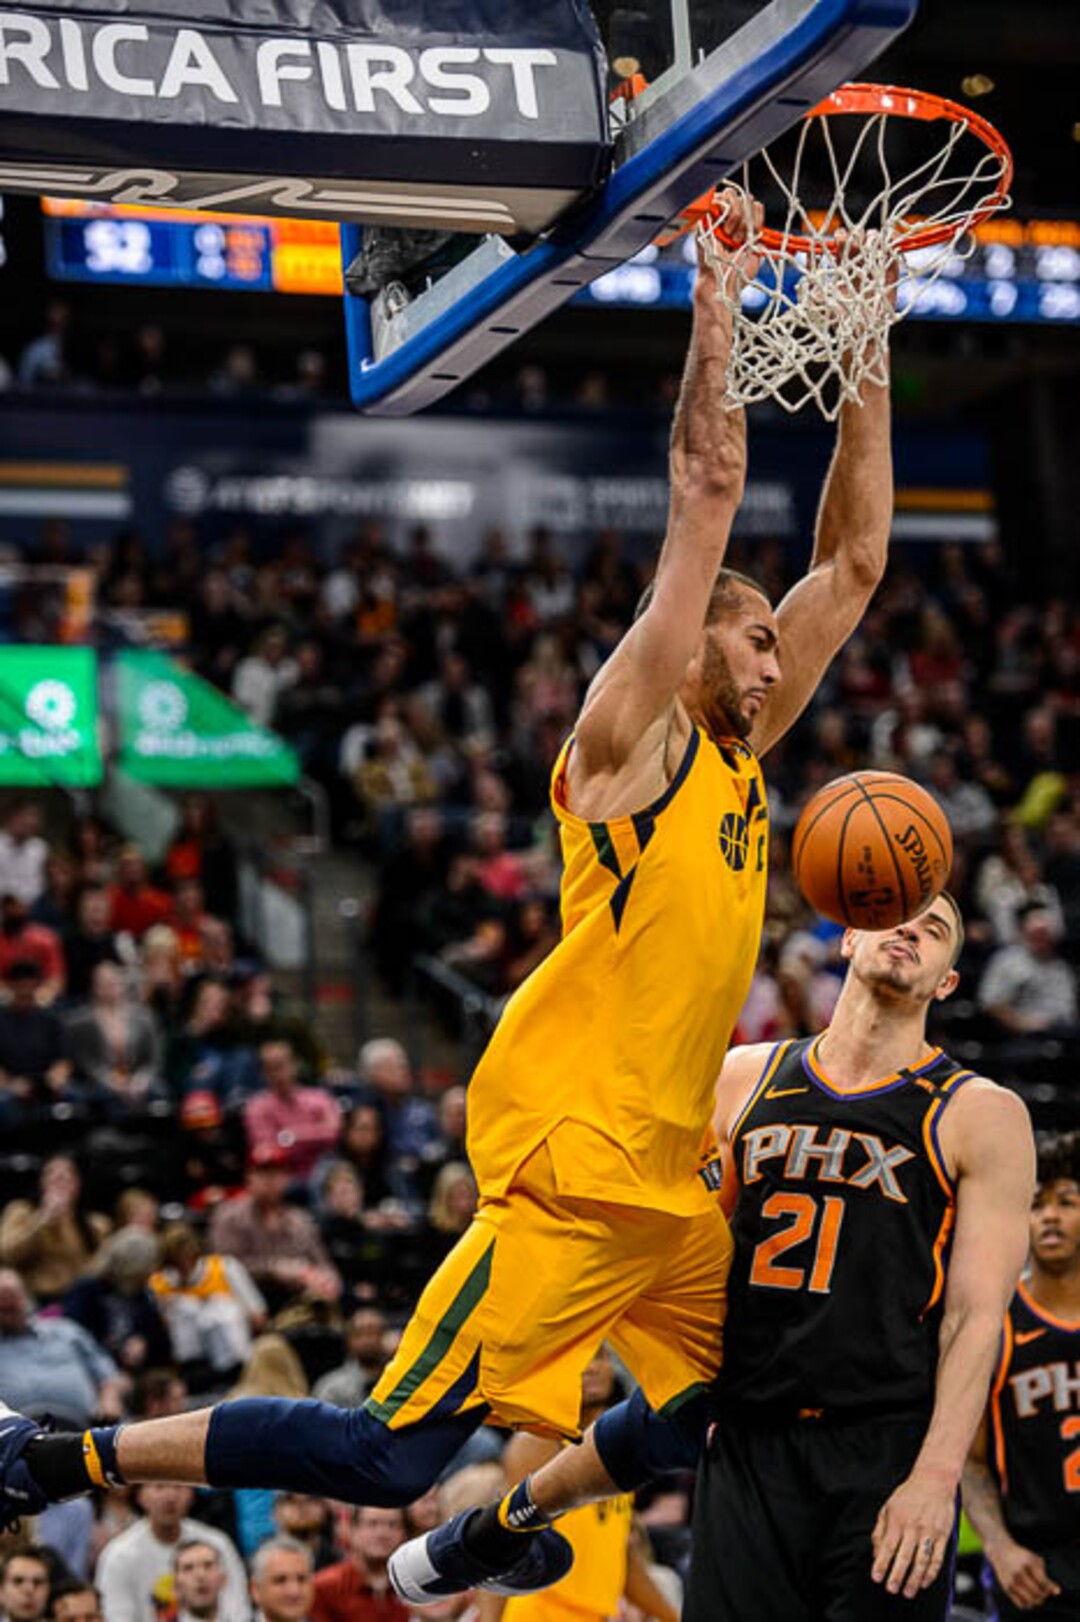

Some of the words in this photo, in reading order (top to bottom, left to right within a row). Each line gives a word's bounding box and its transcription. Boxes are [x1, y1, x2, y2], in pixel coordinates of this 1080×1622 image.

[0, 12, 240, 103] RICA
[255, 38, 557, 119] FIRST
[894, 824, 934, 897] SPALD
[741, 1123, 916, 1204] PHX
[749, 1190, 845, 1294] 21
